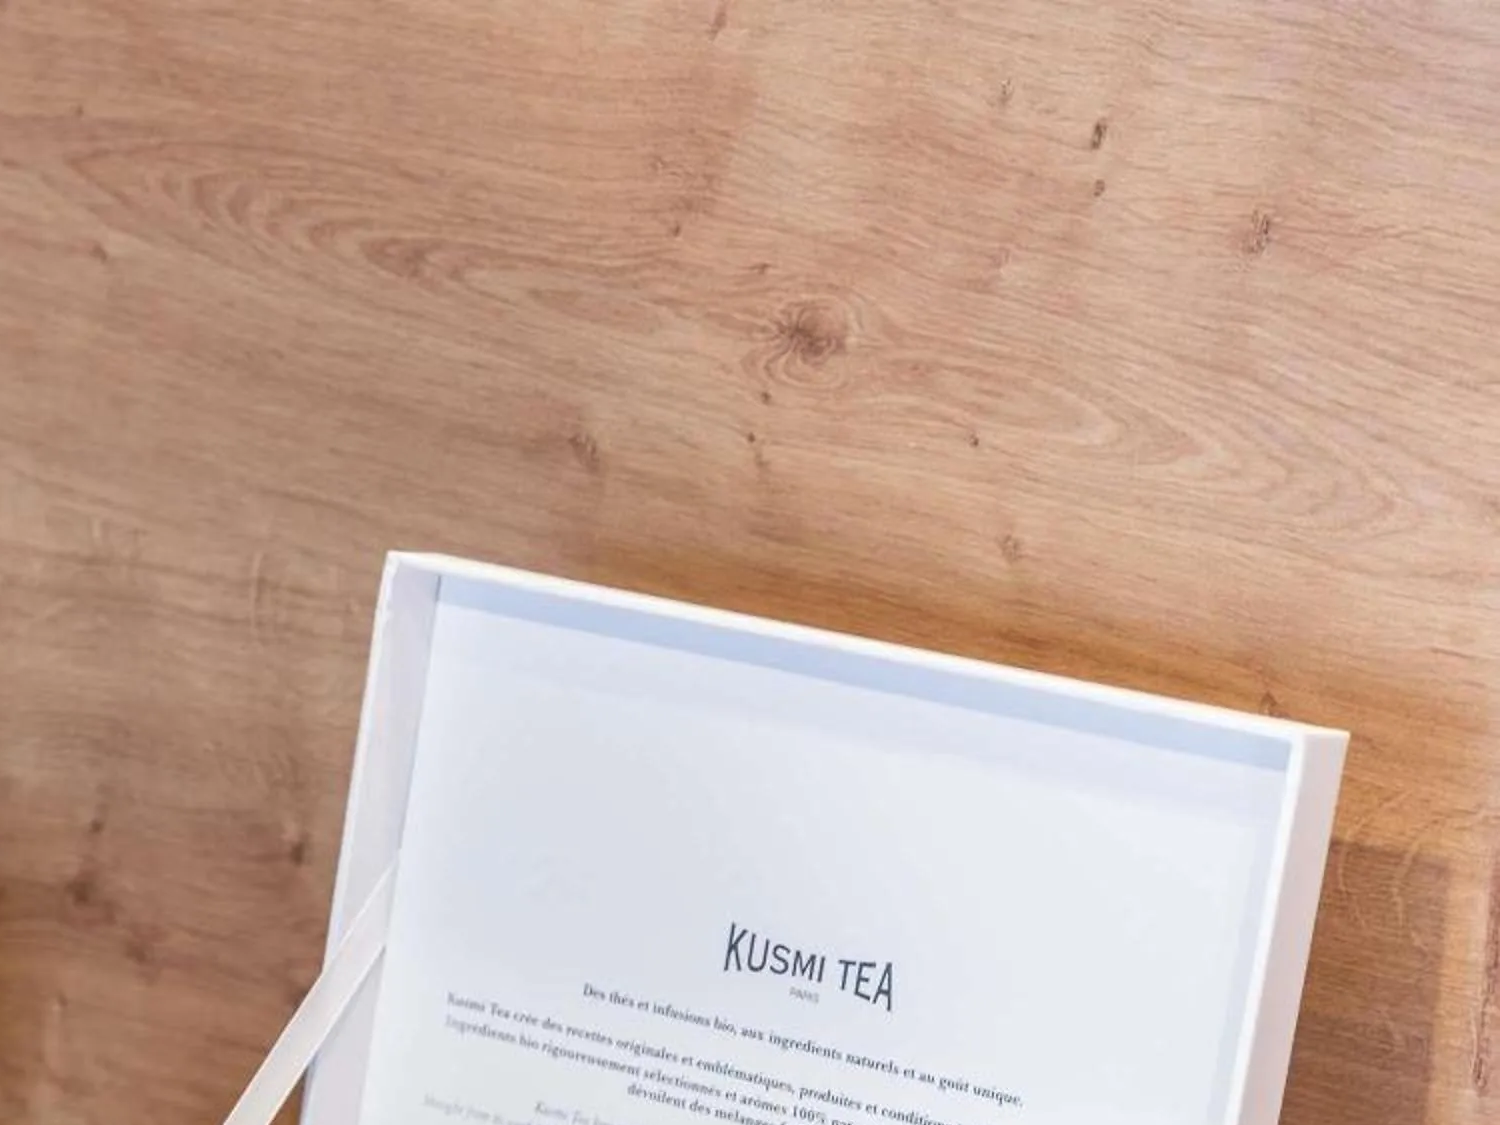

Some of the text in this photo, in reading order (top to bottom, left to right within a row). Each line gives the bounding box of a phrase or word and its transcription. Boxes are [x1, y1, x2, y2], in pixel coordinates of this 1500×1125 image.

[724, 921, 892, 1012] KUSMI TEA
[446, 991, 486, 1013] Kusmi
[491, 1001, 511, 1020] Tea
[513, 1012, 539, 1027] crée
[541, 1017, 564, 1034] des
[566, 1026, 613, 1045] recettes
[614, 1040, 678, 1063] originales
[681, 1055, 693, 1067] et
[696, 1059, 795, 1095] emblématiques,
[798, 1088, 862, 1111] produites
[865, 1104, 877, 1115] et
[519, 1034, 540, 1050] bio
[541, 1042, 640, 1078] rigoureusement
[725, 1091, 737, 1103] et
[740, 1094, 787, 1116] arômes
[793, 1105, 826, 1124] 100%
[583, 982, 1024, 1108] Des thés et infusions bio, aux ingrédients naturels et au goût unique.
[627, 1082, 687, 1110] dévoilent
[689, 1099, 711, 1115] des
